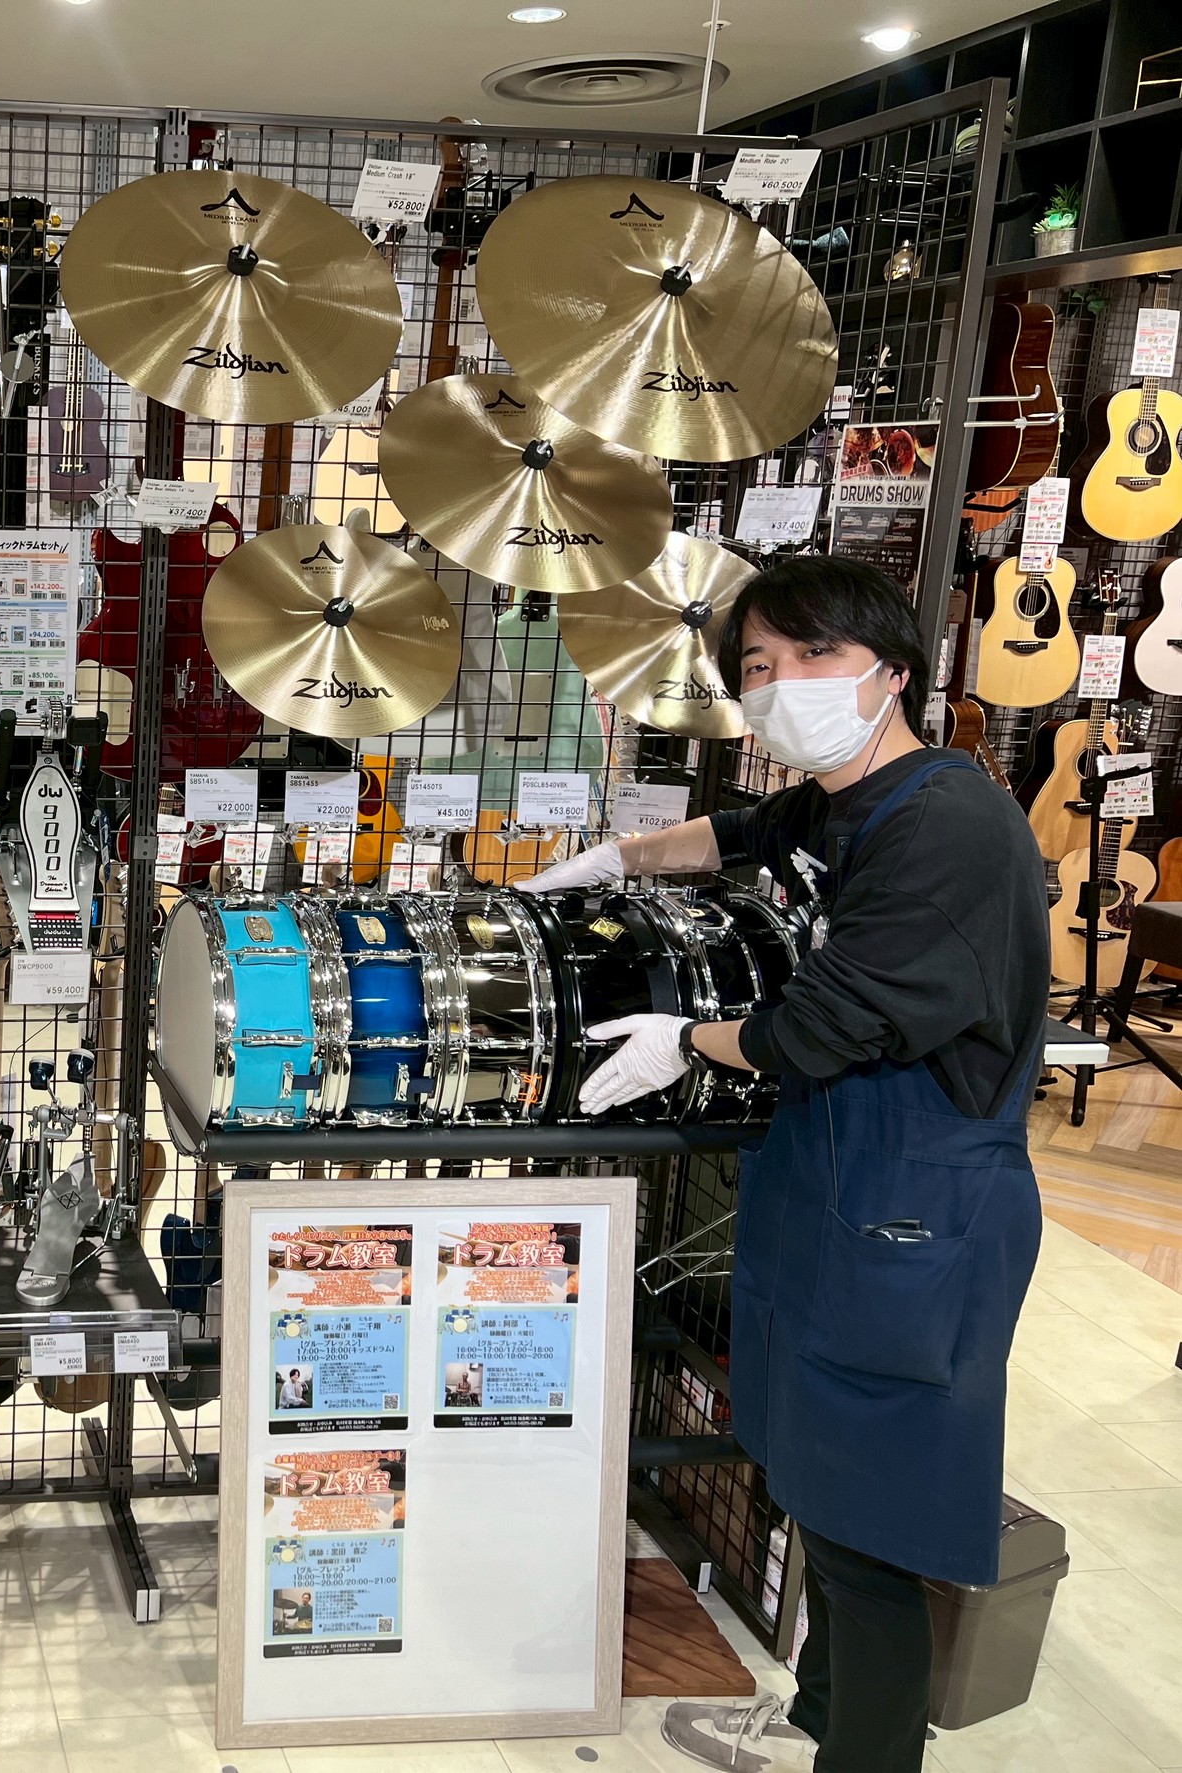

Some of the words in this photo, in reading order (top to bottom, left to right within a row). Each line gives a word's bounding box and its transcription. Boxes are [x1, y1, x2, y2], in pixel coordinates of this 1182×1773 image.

[366, 169, 386, 178] Medium
[388, 171, 403, 180] Crash
[203, 213, 234, 221] MEDIUM
[181, 343, 290, 380] Zildjian
[641, 365, 739, 401] Zildjian
[839, 484, 884, 504] DRUMS
[886, 485, 926, 505] SHOW
[505, 519, 603, 554] Zildjian
[290, 671, 394, 709] Zildjian
[654, 672, 738, 709] Zildjia
[189, 778, 219, 786] SBS1455
[289, 779, 319, 787] SBS1455
[410, 783, 444, 791] US1450TS
[37, 783, 64, 799] dw
[618, 791, 642, 799] LM402
[217, 803, 251, 812] ¥22,000
[317, 805, 352, 814] ¥22,000
[437, 807, 471, 817] ¥45,100
[549, 806, 583, 816] ¥53,600
[42, 804, 62, 872] 9000
[17, 962, 54, 971] DWCP9000
[46, 986, 82, 995] ¥59,400
[284, 1242, 399, 1269] ドラム教室
[453, 1242, 566, 1267] ドラム教室
[279, 1471, 392, 1497] ドラム教室
